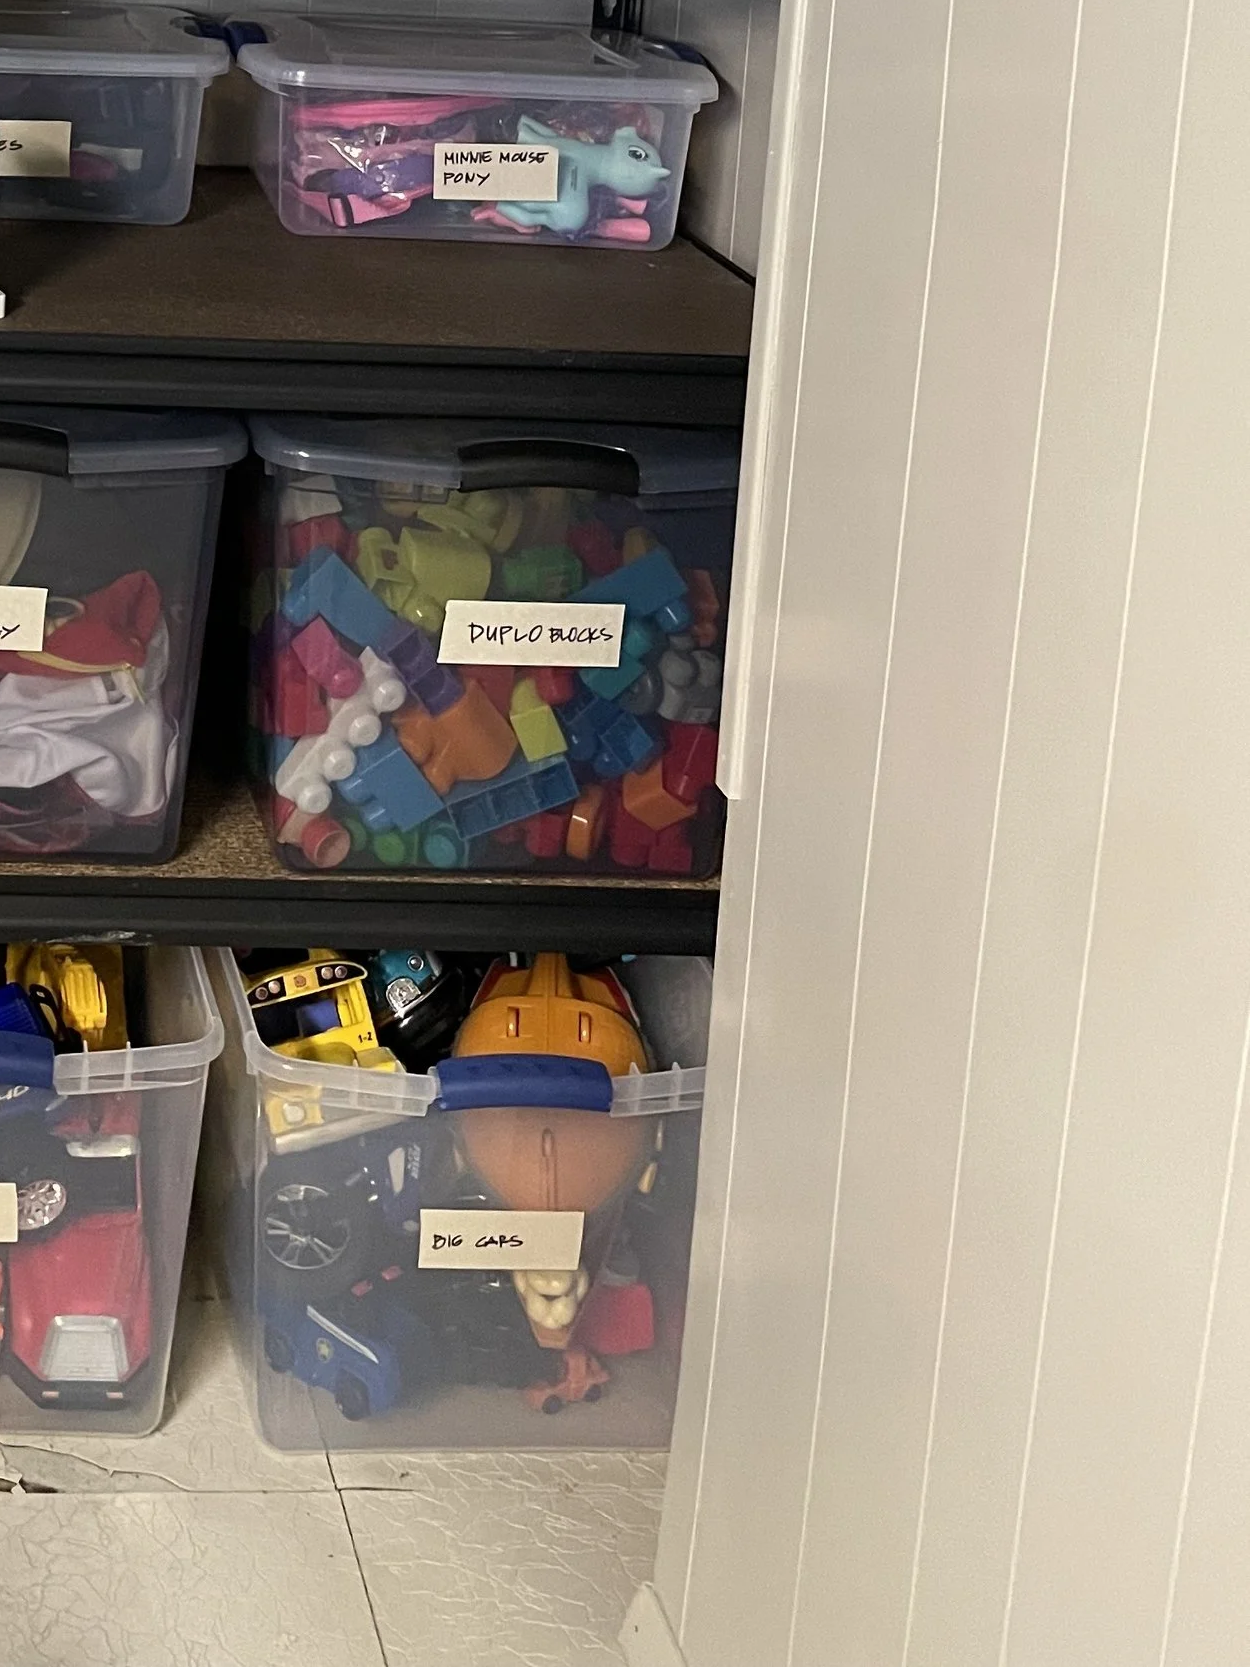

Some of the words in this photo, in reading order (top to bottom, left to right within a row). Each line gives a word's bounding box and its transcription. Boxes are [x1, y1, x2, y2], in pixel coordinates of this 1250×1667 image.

[444, 150, 493, 166] MINNIE
[499, 151, 549, 164] MOUSE
[443, 172, 490, 186] PONY
[468, 621, 543, 645] DUPLO
[549, 626, 615, 644] BLOCKS
[431, 1234, 464, 1250] BIG
[475, 1234, 524, 1249] CARS
